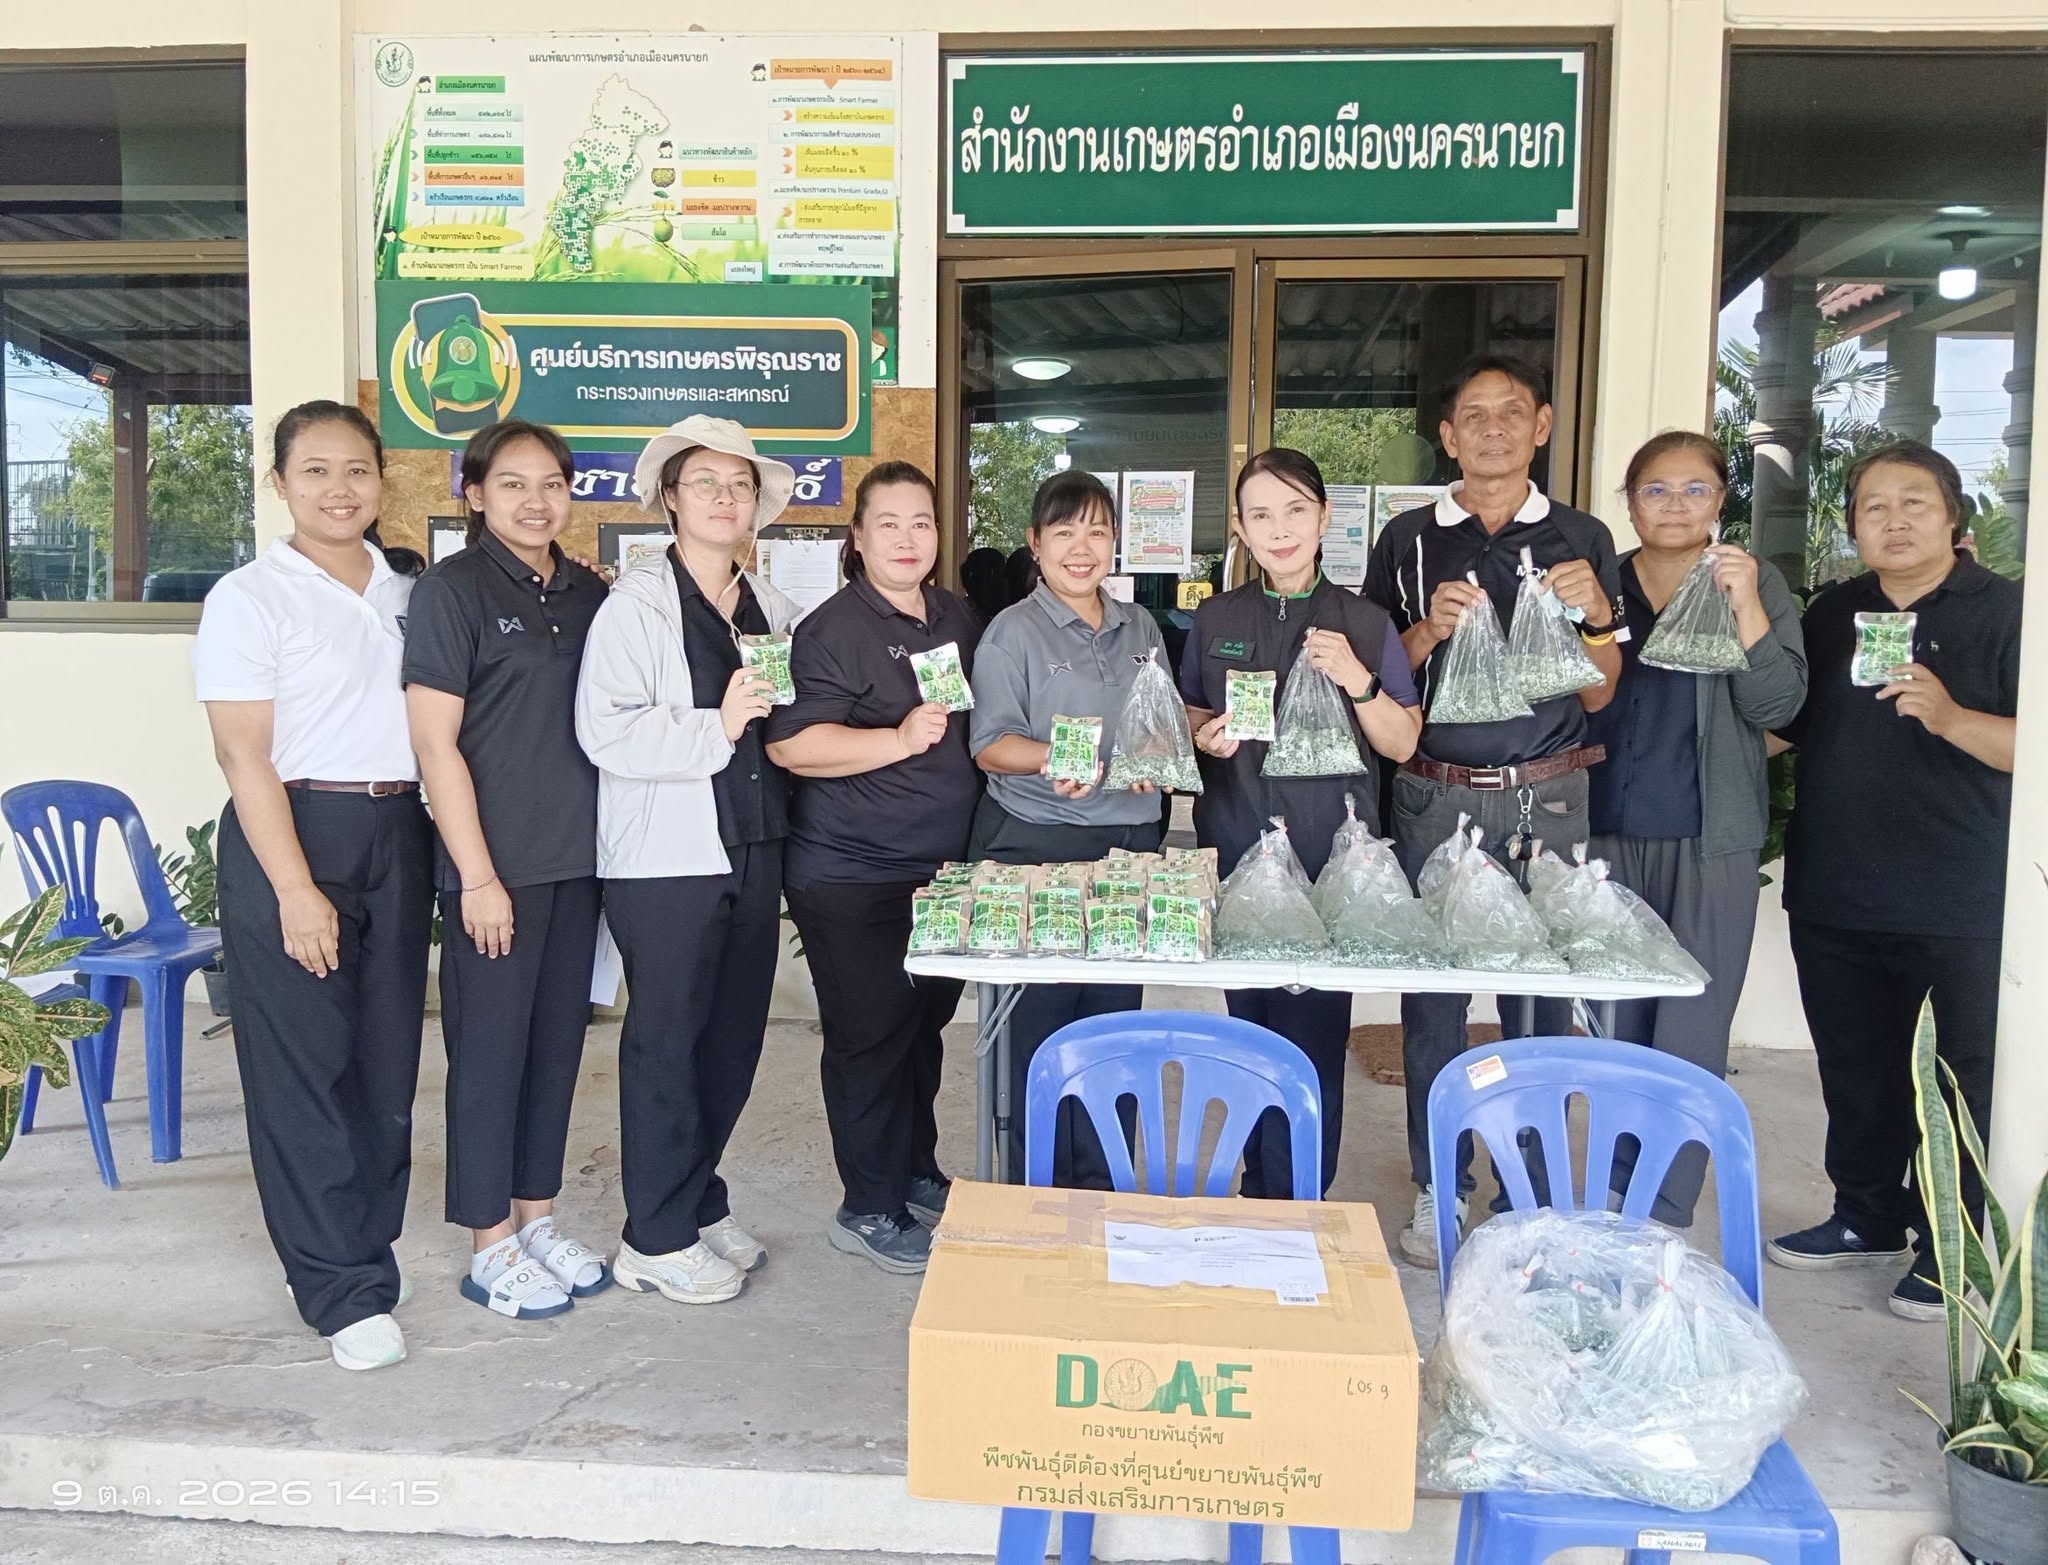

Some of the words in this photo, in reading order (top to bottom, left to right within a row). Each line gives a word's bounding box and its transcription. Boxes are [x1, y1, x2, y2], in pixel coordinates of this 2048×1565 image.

[529, 49, 709, 64] แผนพัฒนาการเกษตรอำเภอเมืองนครนายก
[960, 102, 1566, 174] สำนักงานเกษตรอำเภอเมืองนครนายก
[713, 174, 725, 184] ข้าว
[479, 262, 499, 270] Smart
[500, 263, 523, 271] Farmer
[530, 341, 842, 380] ศูนย์บริการเกษตรพิรุณราช
[576, 383, 790, 404] กระทรวงเกษตรและสหกรณ์
[1081, 1422, 1224, 1449] กองขยายพันธุ์พืช
[982, 1446, 1323, 1494] พืชพันธุ์ดีต้องที่ศูนย์ขยายพันธุ์พืช
[1016, 1482, 1285, 1519] กรมส่งเสริมการเกษตร
